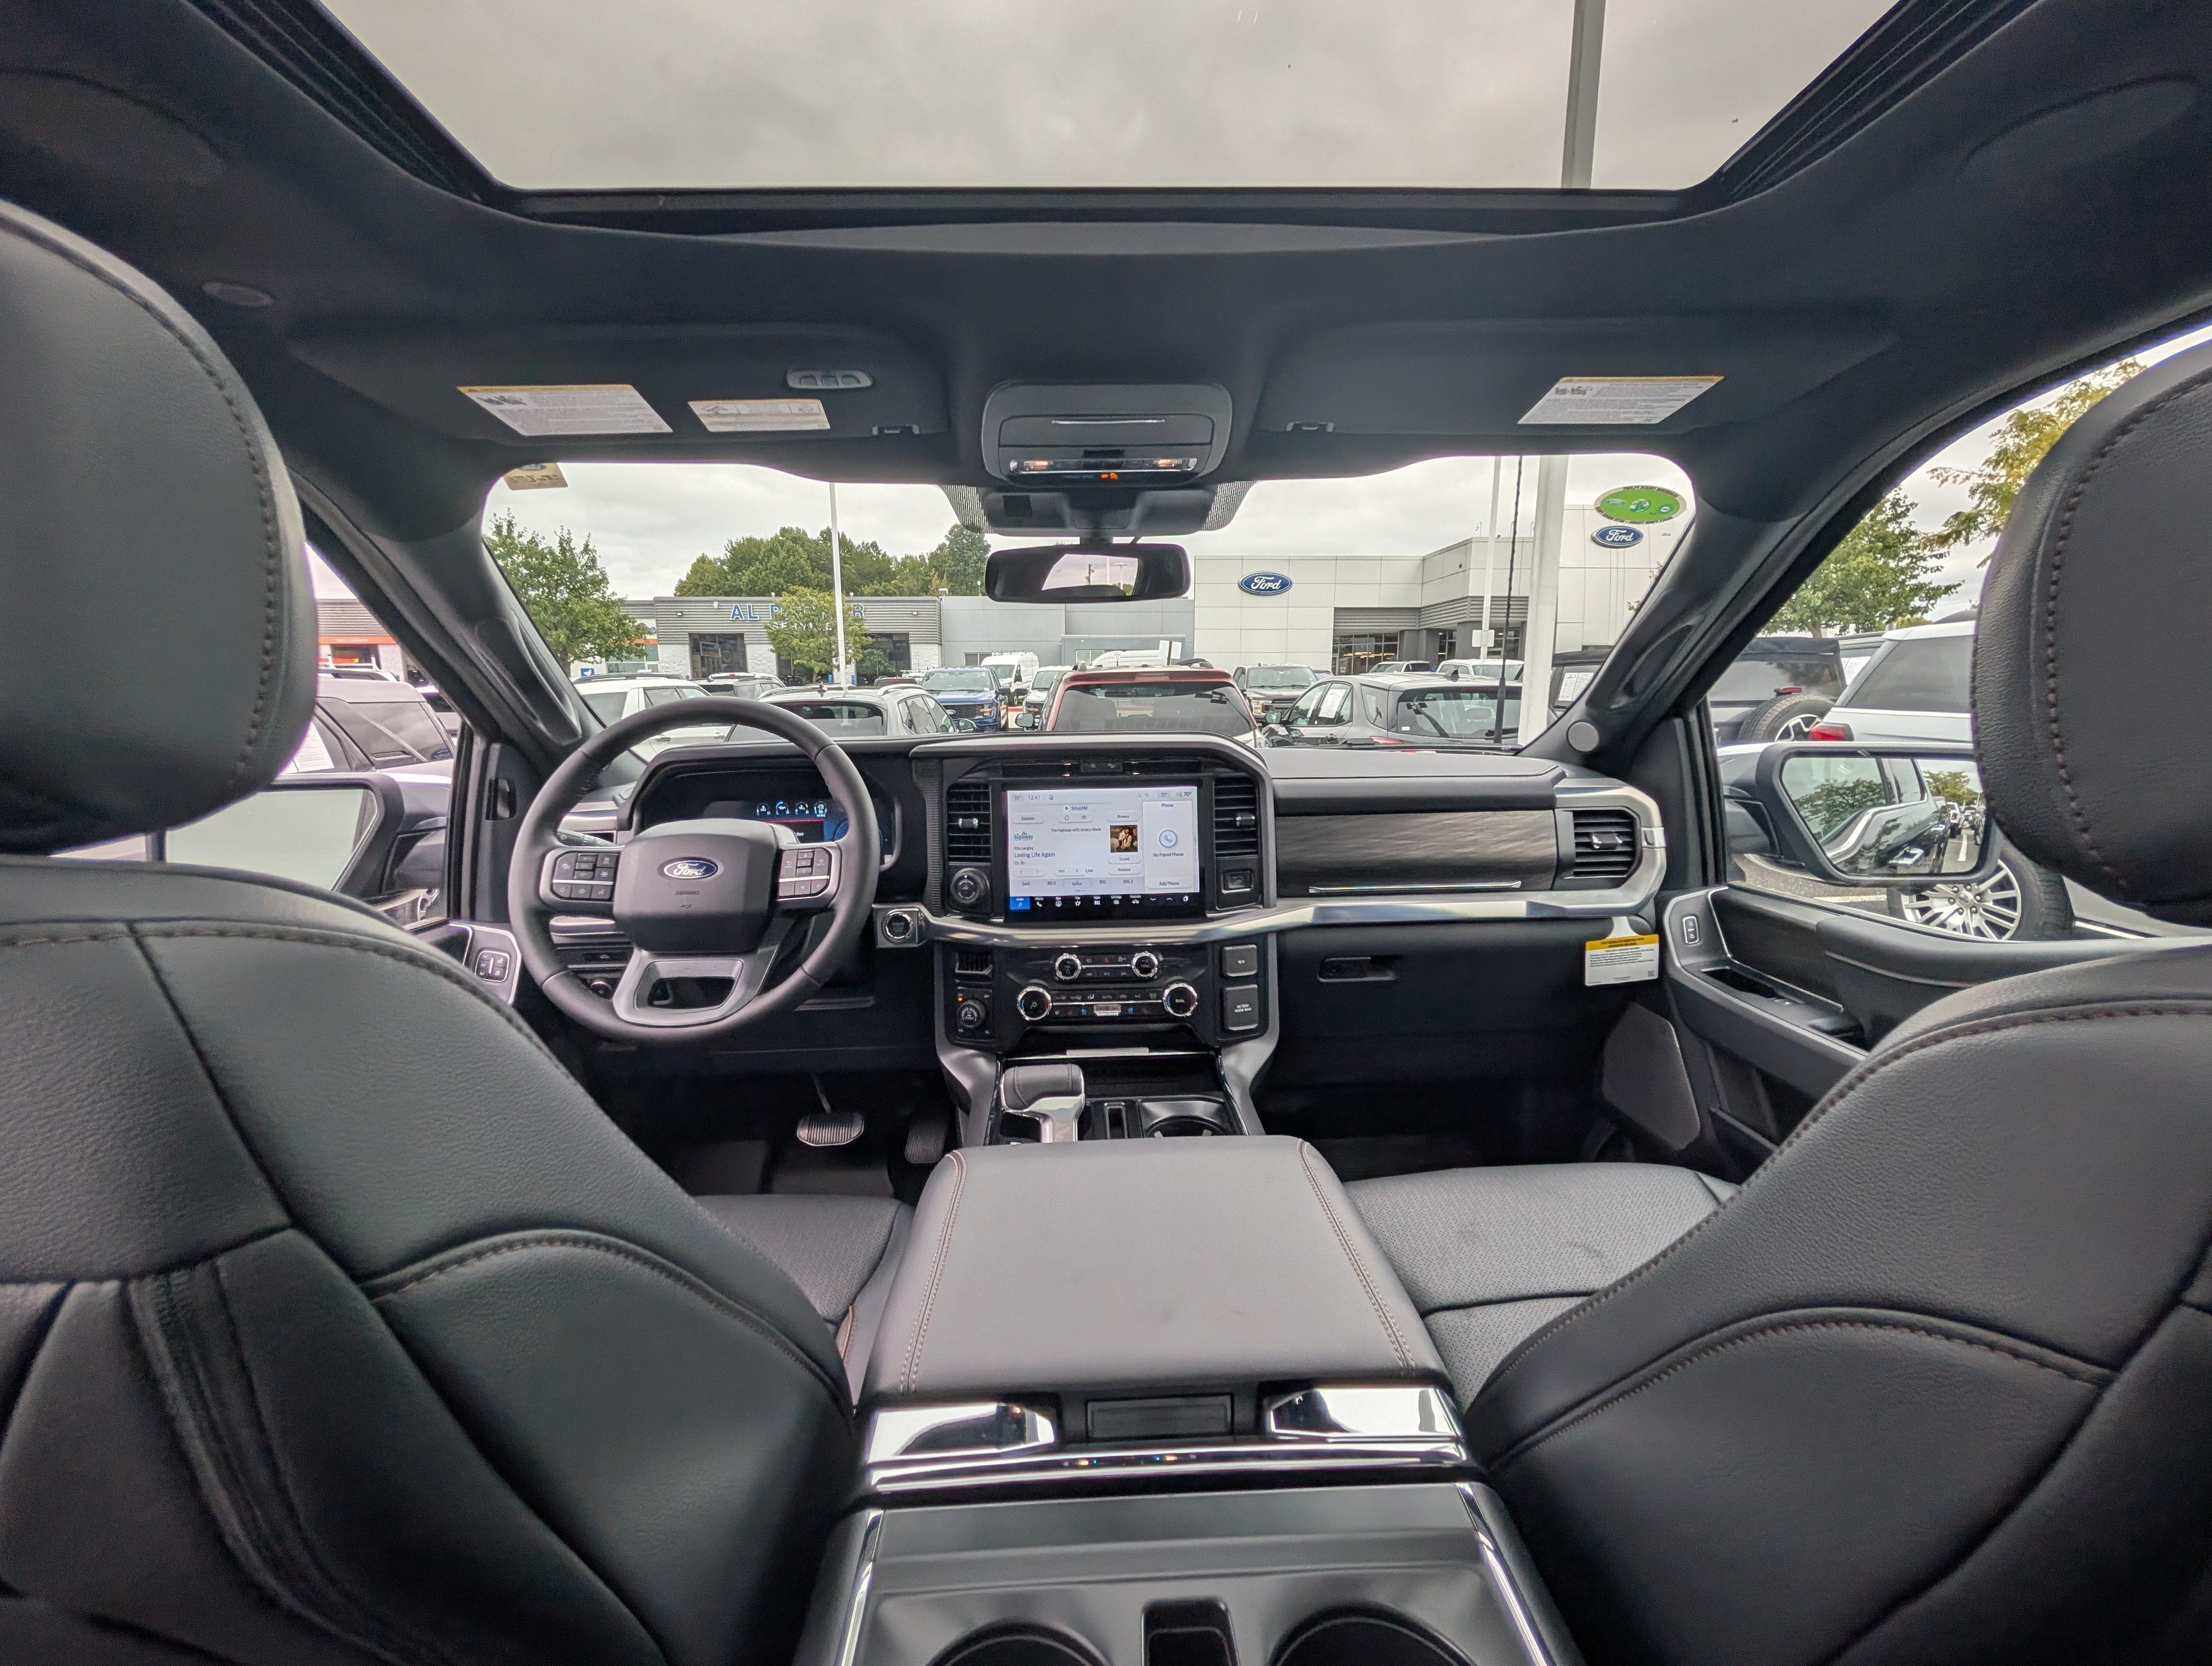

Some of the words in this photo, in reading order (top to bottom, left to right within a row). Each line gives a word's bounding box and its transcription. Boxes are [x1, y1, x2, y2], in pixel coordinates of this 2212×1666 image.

[1606, 529, 1635, 541] Ford
[1251, 576, 1282, 589] Ford
[730, 604, 760, 620] AL
[674, 863, 706, 875] Ford
